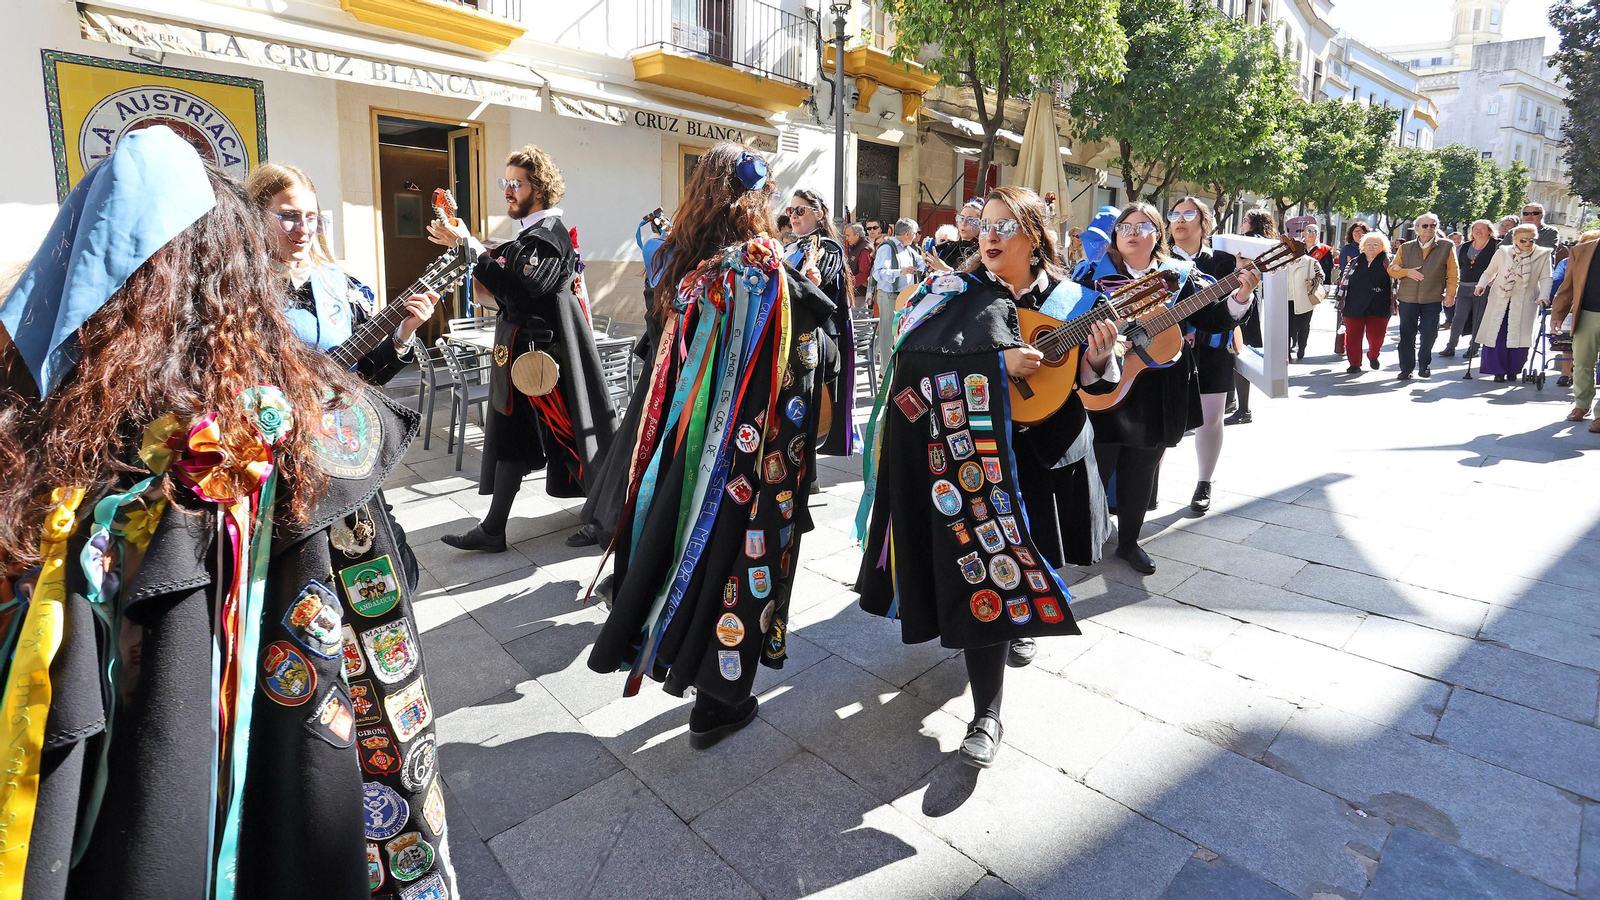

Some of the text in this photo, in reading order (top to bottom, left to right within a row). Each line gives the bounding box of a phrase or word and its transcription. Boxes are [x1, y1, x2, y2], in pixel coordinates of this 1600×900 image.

[150, 33, 183, 44] PEPE
[196, 29, 480, 96] LA CRUZ BLANCA
[90, 93, 242, 167] LA AUSTRIACA
[634, 111, 679, 133] CRUZ
[687, 121, 744, 144] BLANCA
[733, 328, 741, 342] EL
[726, 351, 737, 378] AMOR
[720, 389, 731, 403] ES
[712, 410, 726, 434] COSA
[706, 444, 717, 458] DE
[701, 463, 711, 474] 2
[707, 475, 725, 498] SE
[700, 501, 717, 519] EL
[676, 526, 709, 583] MEJOR
[355, 714, 380, 723] ARCELONA
[357, 728, 387, 737] GIRONA
